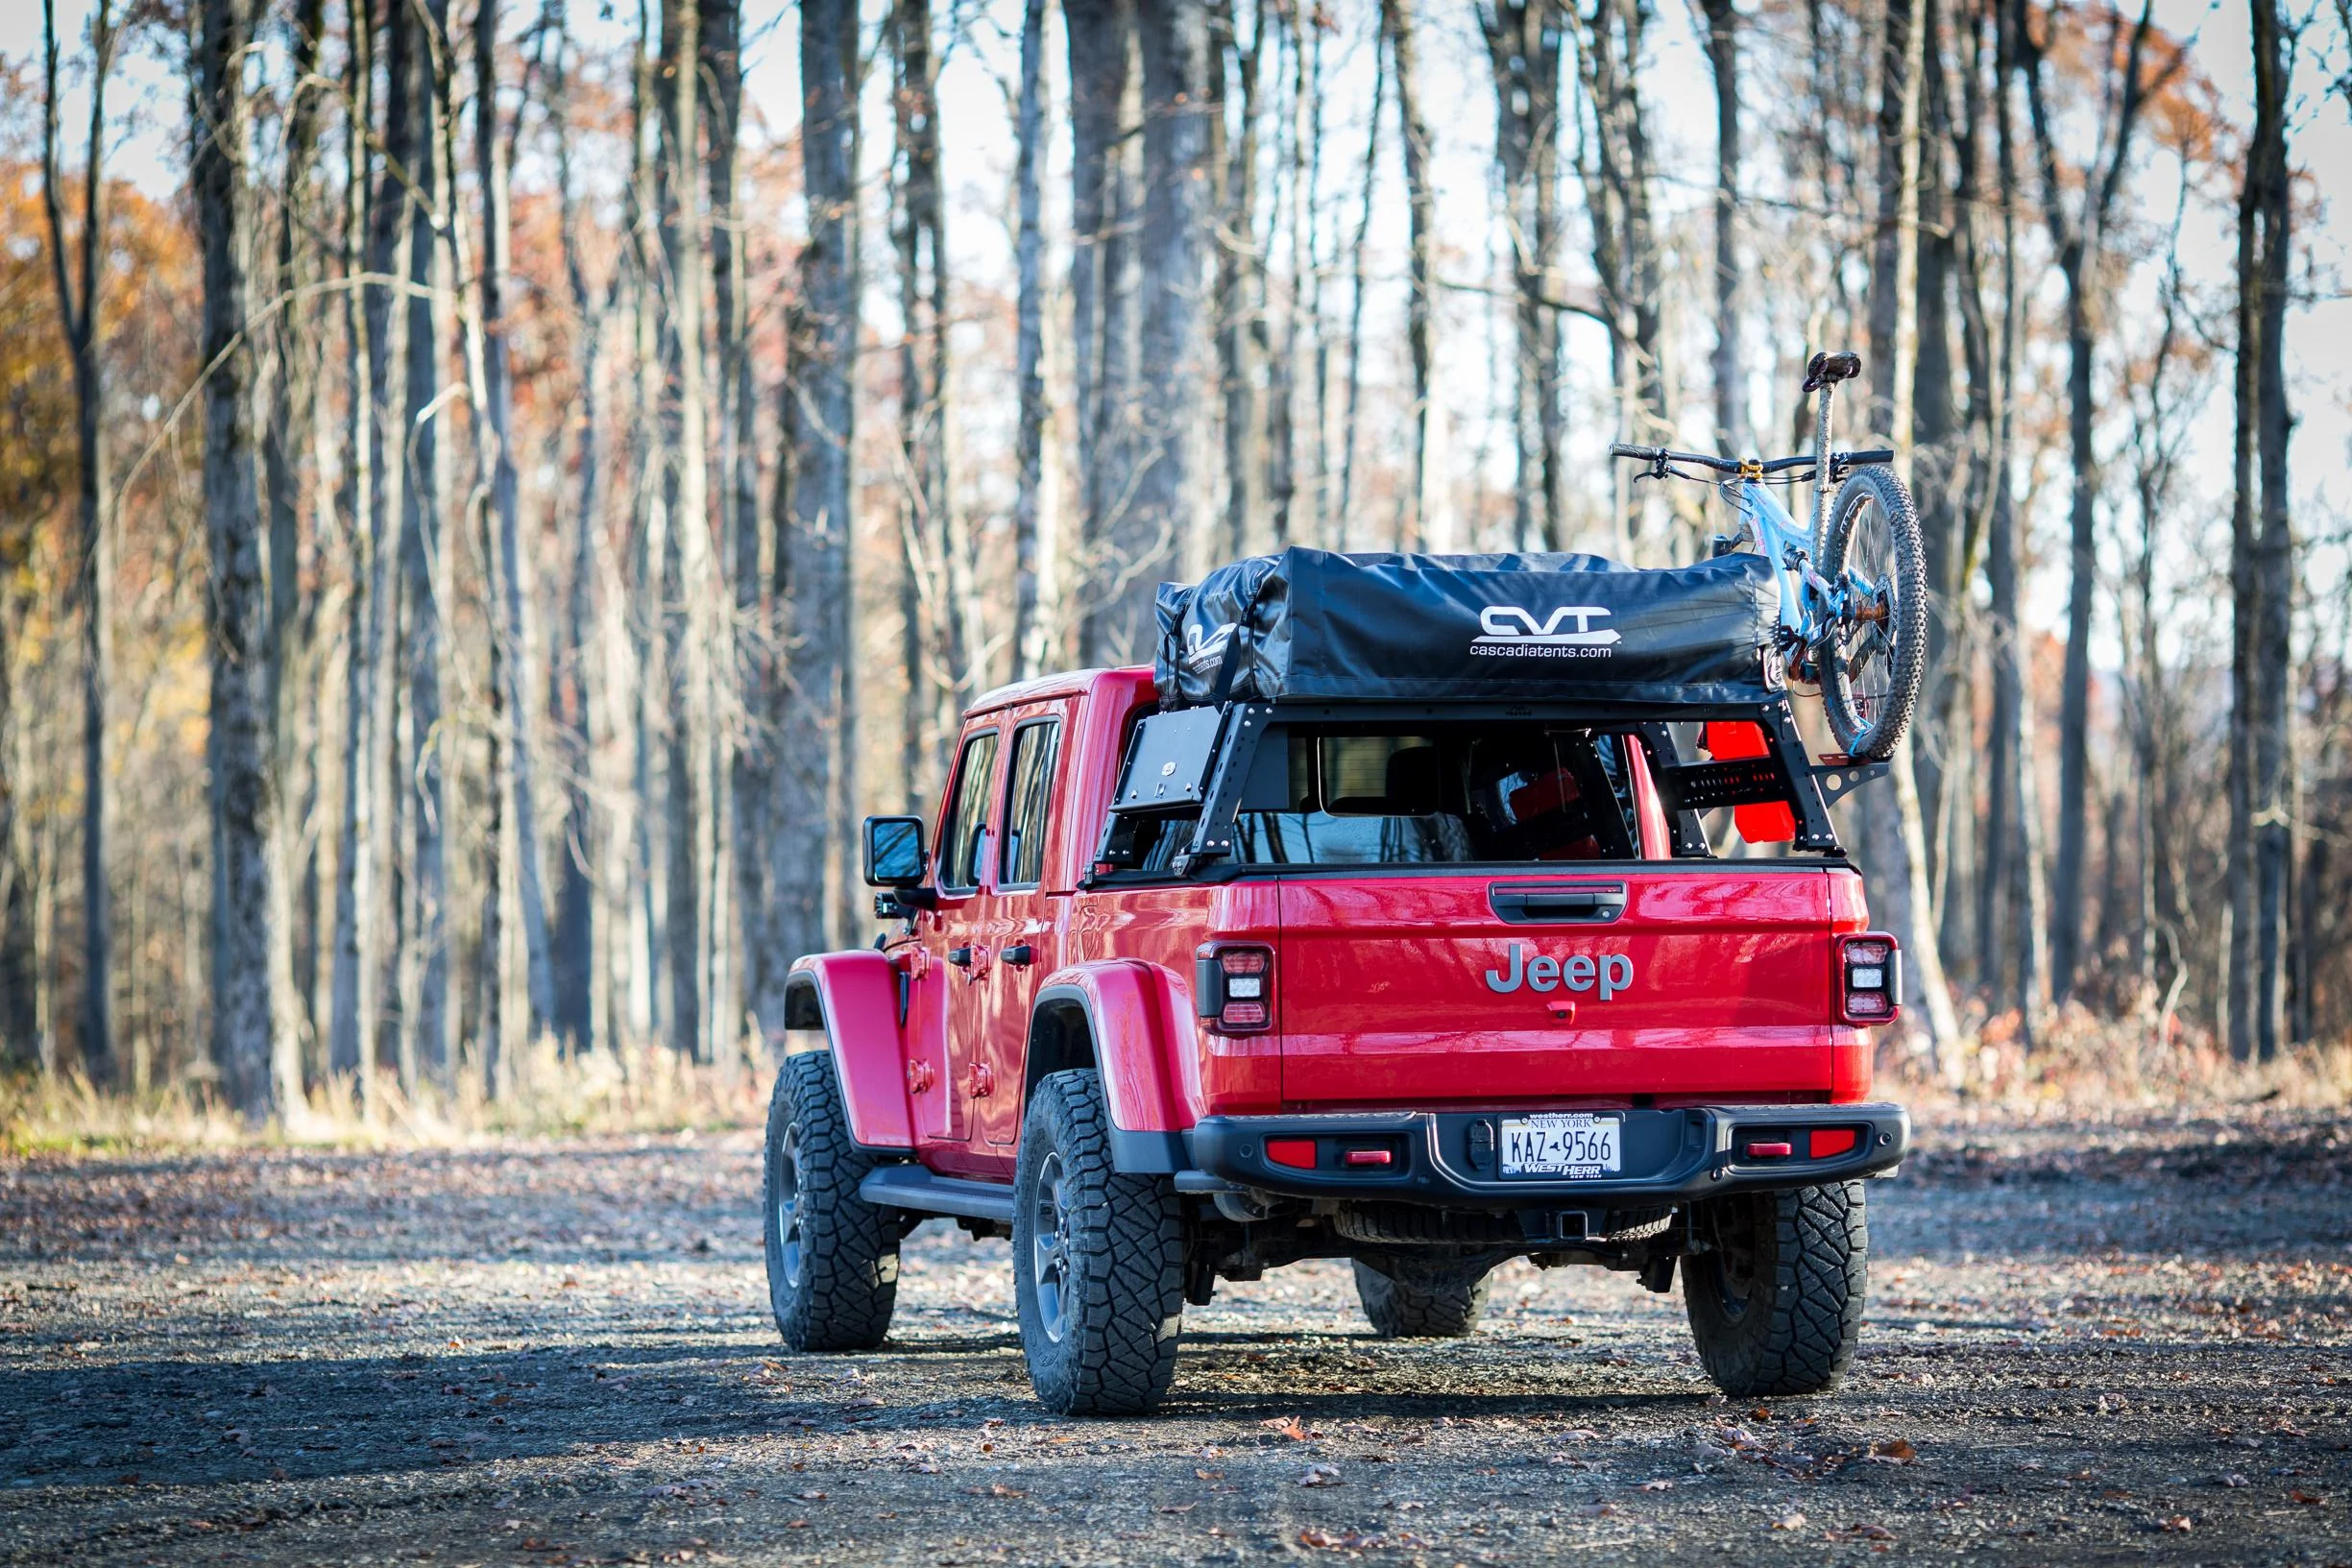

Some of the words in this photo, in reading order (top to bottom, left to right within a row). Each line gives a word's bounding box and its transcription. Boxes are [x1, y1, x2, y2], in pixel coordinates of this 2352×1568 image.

[1480, 605, 1612, 636] CVT
[1469, 643, 1612, 658] cascadiatents.com
[1485, 944, 1634, 1001] Jeep
[1531, 1119, 1558, 1128] NEW
[1561, 1119, 1591, 1128] YORK
